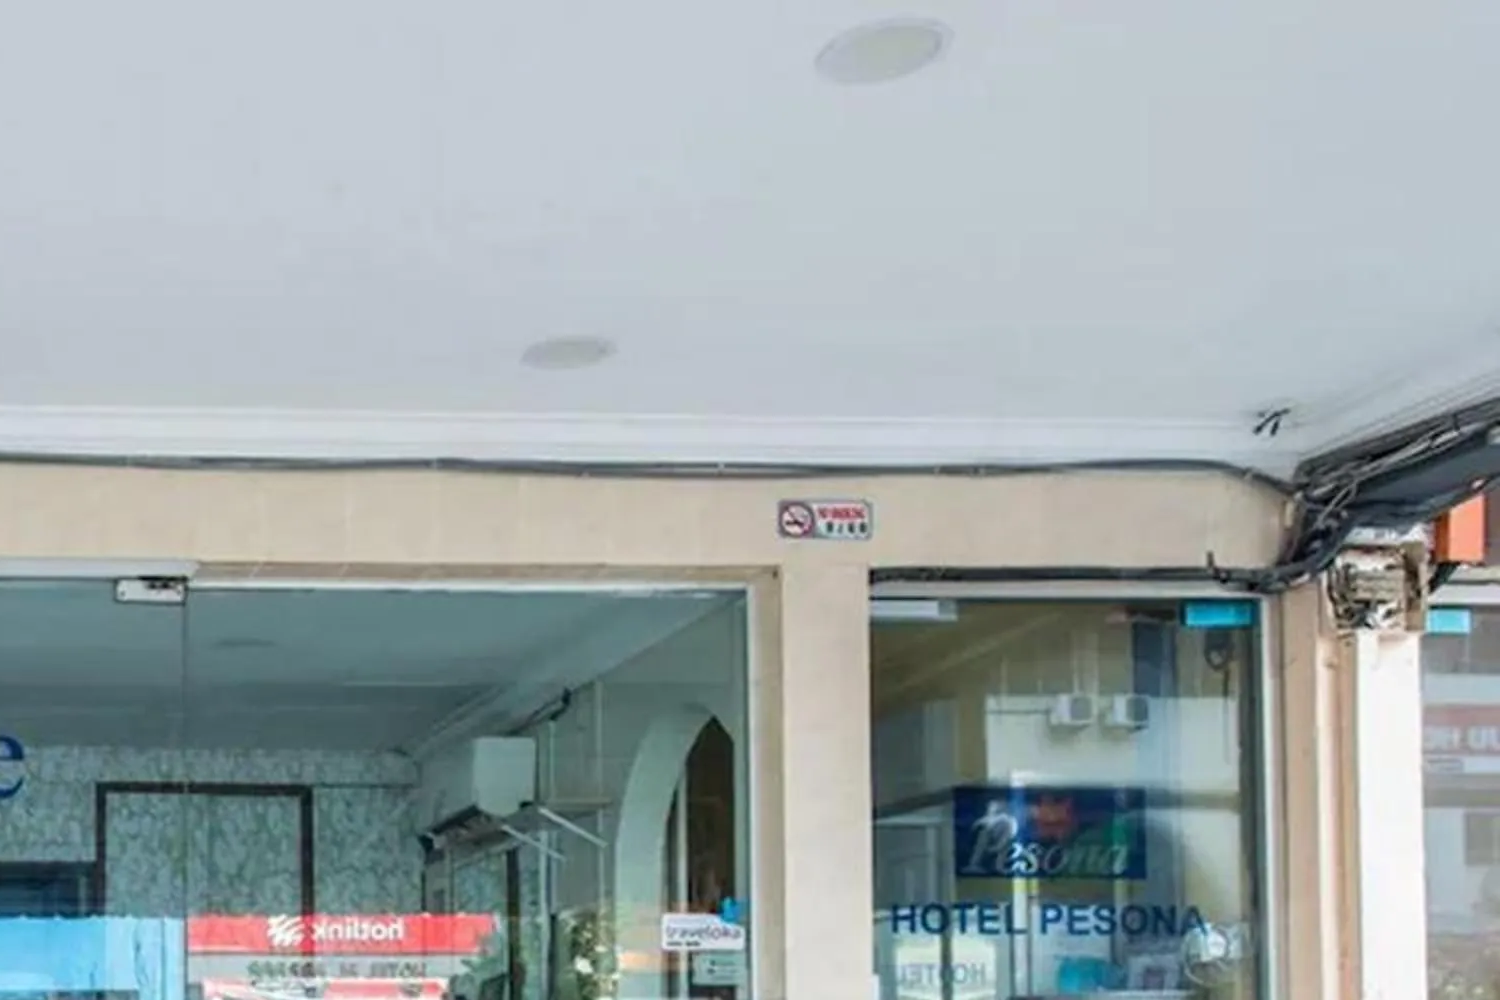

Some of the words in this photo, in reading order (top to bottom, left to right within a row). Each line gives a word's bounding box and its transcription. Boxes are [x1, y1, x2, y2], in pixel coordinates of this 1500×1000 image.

[960, 800, 1130, 876] Pesona
[891, 902, 1027, 936] HOTEL
[1040, 904, 1209, 937] PESONA
